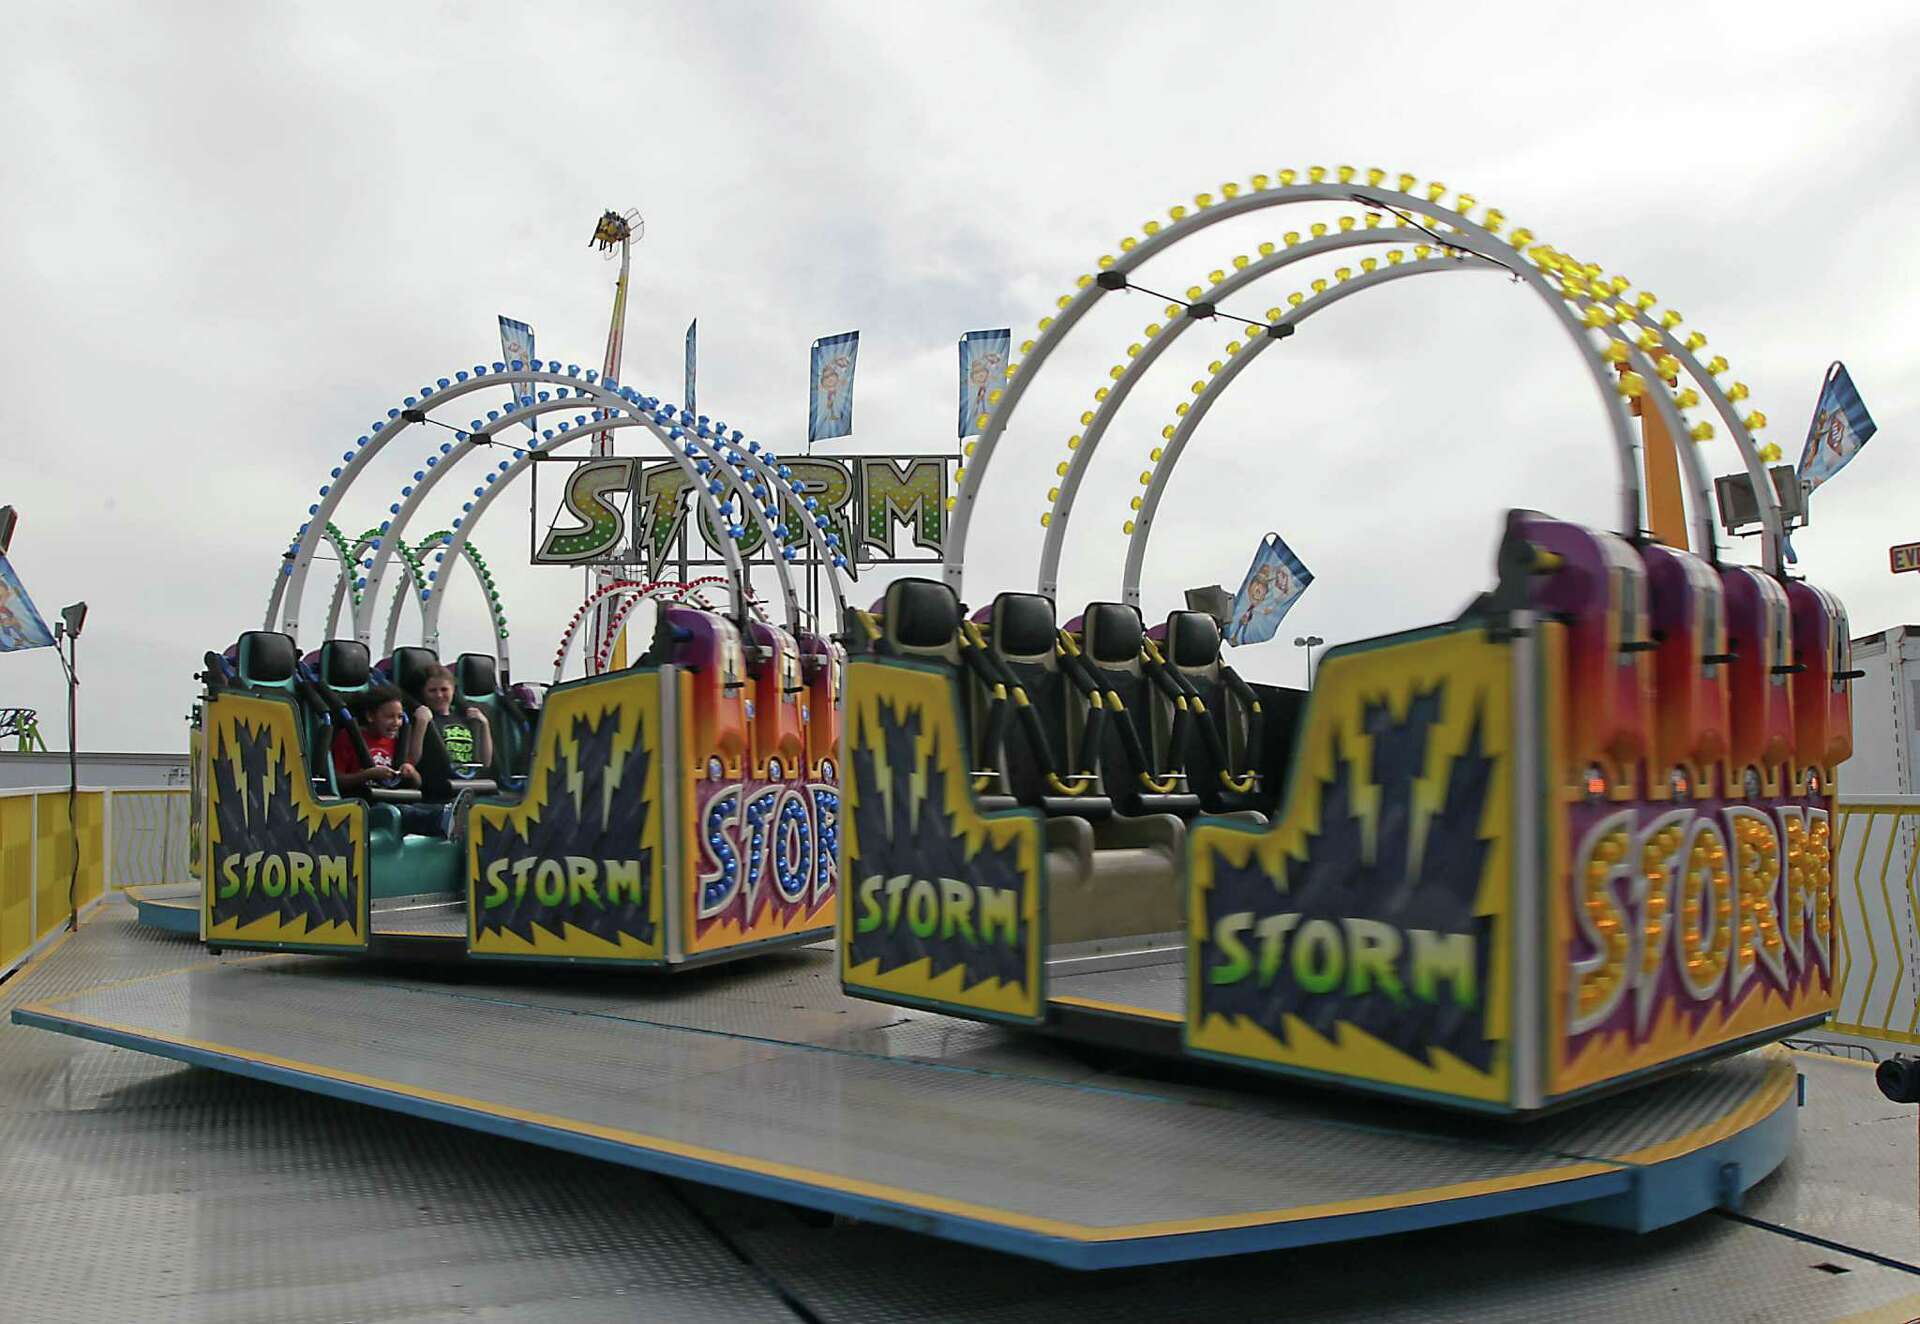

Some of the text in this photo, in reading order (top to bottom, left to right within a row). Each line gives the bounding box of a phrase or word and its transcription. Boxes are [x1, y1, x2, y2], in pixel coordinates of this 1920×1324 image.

[538, 458, 948, 581] STORM
[1894, 547, 1920, 568] EV
[220, 850, 350, 899] STORM
[485, 856, 642, 911] STORM
[699, 783, 840, 922] STOR
[858, 874, 1019, 946] STORM
[1570, 806, 1832, 1036] STORM
[1211, 912, 1476, 1007] STORM
